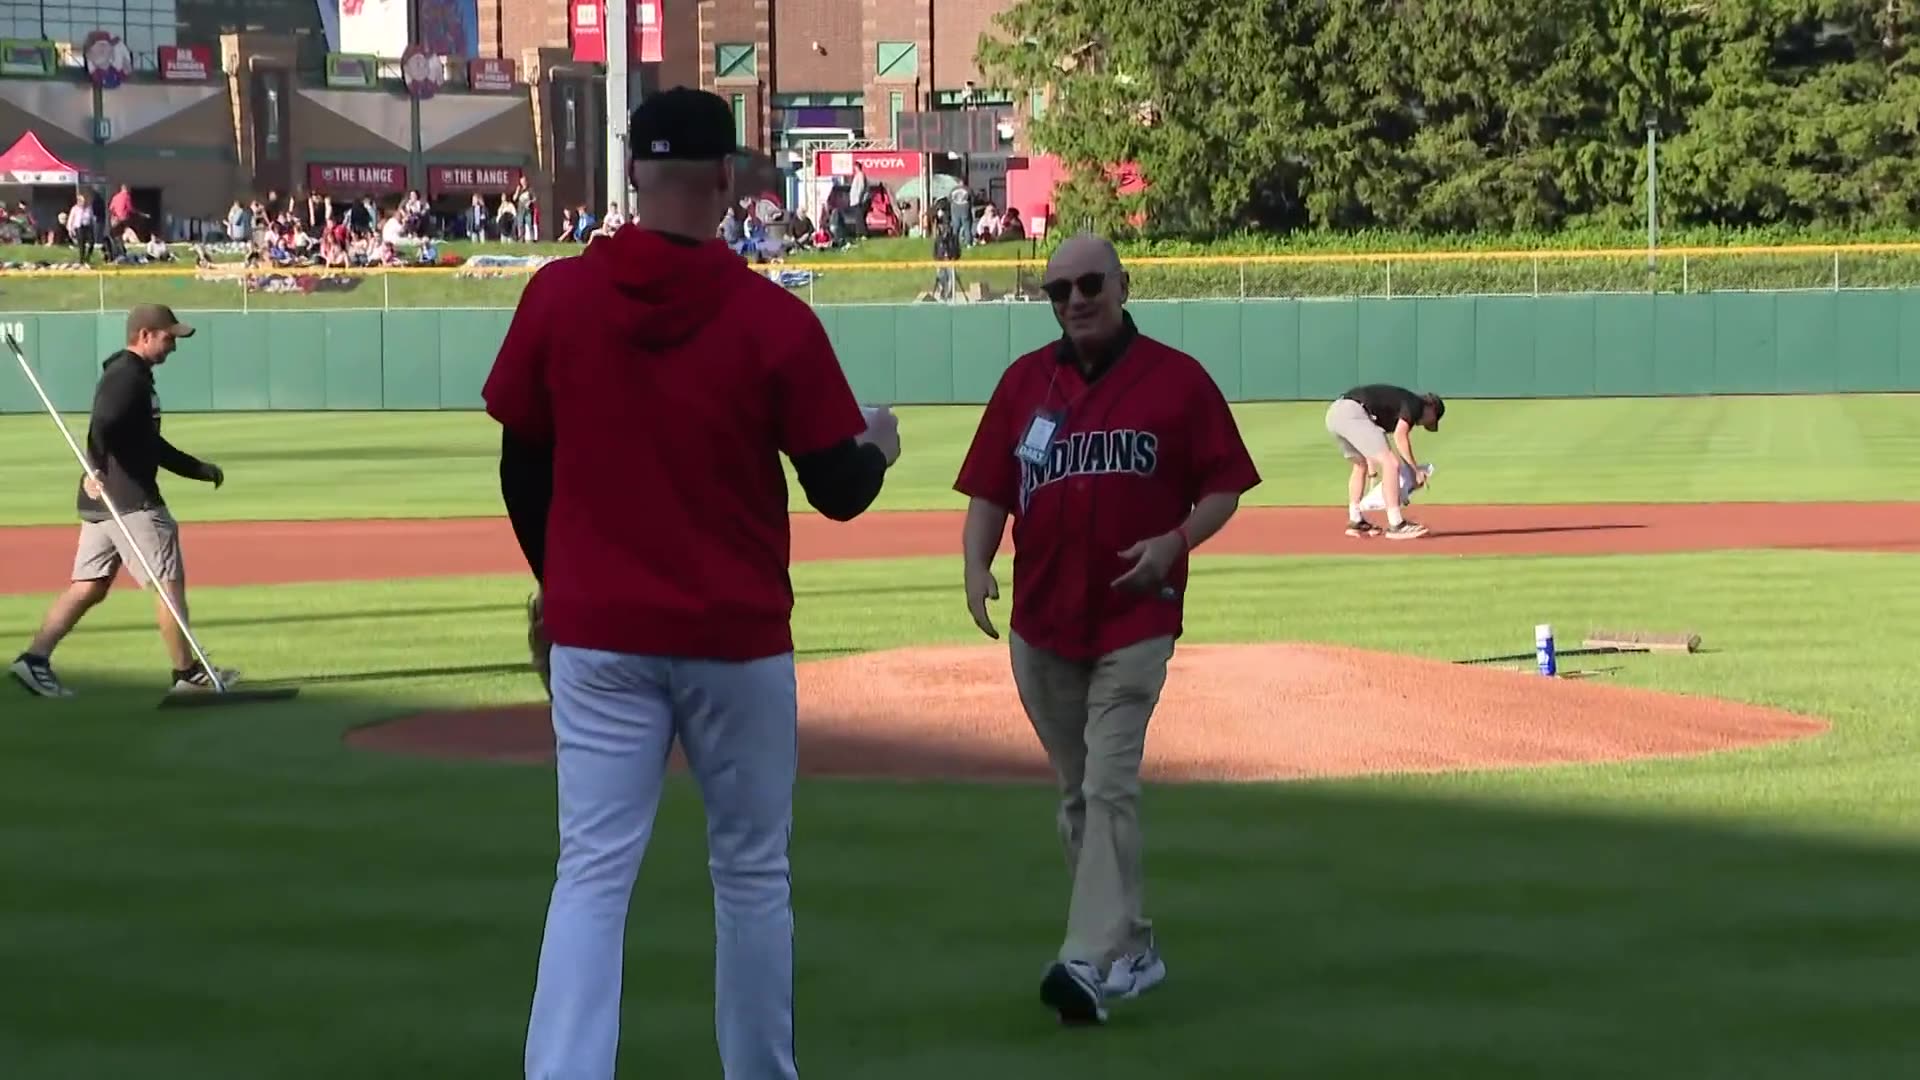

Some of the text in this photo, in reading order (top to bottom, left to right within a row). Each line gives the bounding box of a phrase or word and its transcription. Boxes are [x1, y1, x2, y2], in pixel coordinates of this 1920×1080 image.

[855, 157, 905, 169] TOYOTA
[334, 167, 394, 183] THE RANGE
[454, 168, 509, 185] THE RANGE
